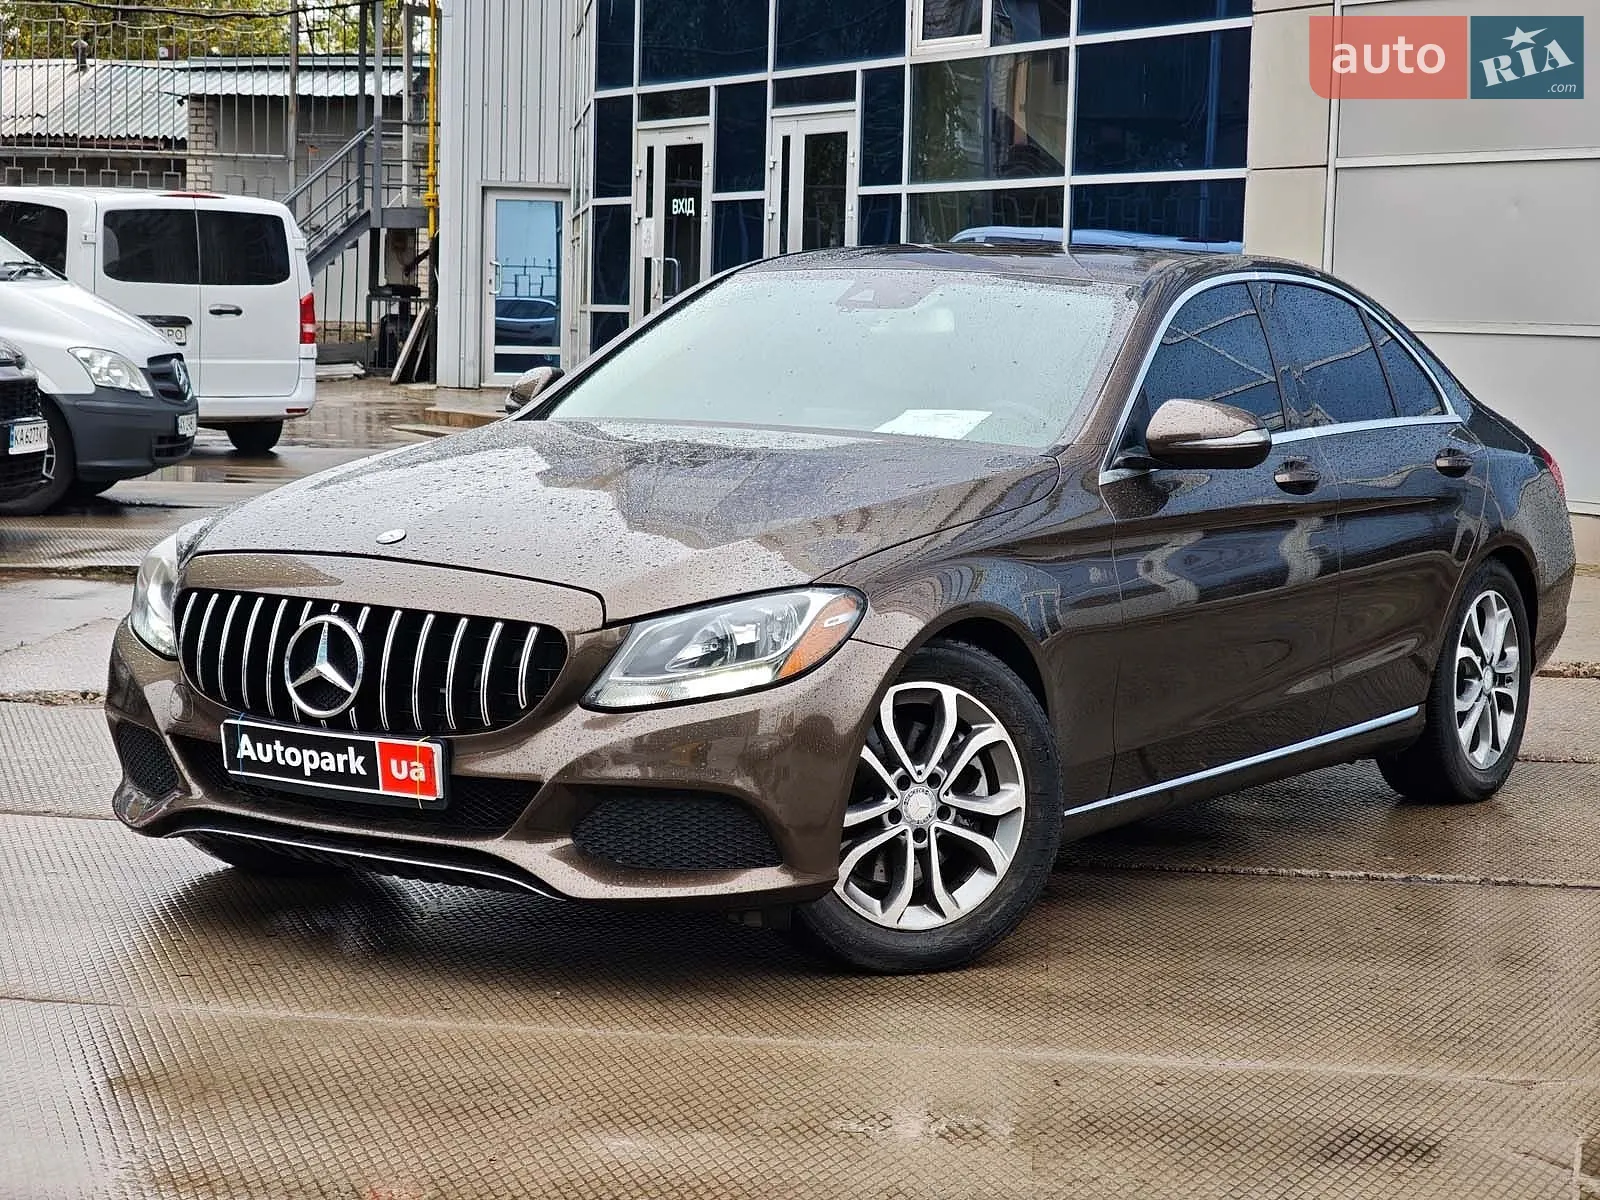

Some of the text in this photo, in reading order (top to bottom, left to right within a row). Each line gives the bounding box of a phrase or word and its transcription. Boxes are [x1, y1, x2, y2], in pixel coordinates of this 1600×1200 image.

[672, 197, 695, 216] ВХІД
[237, 733, 426, 782] Autopark ua
